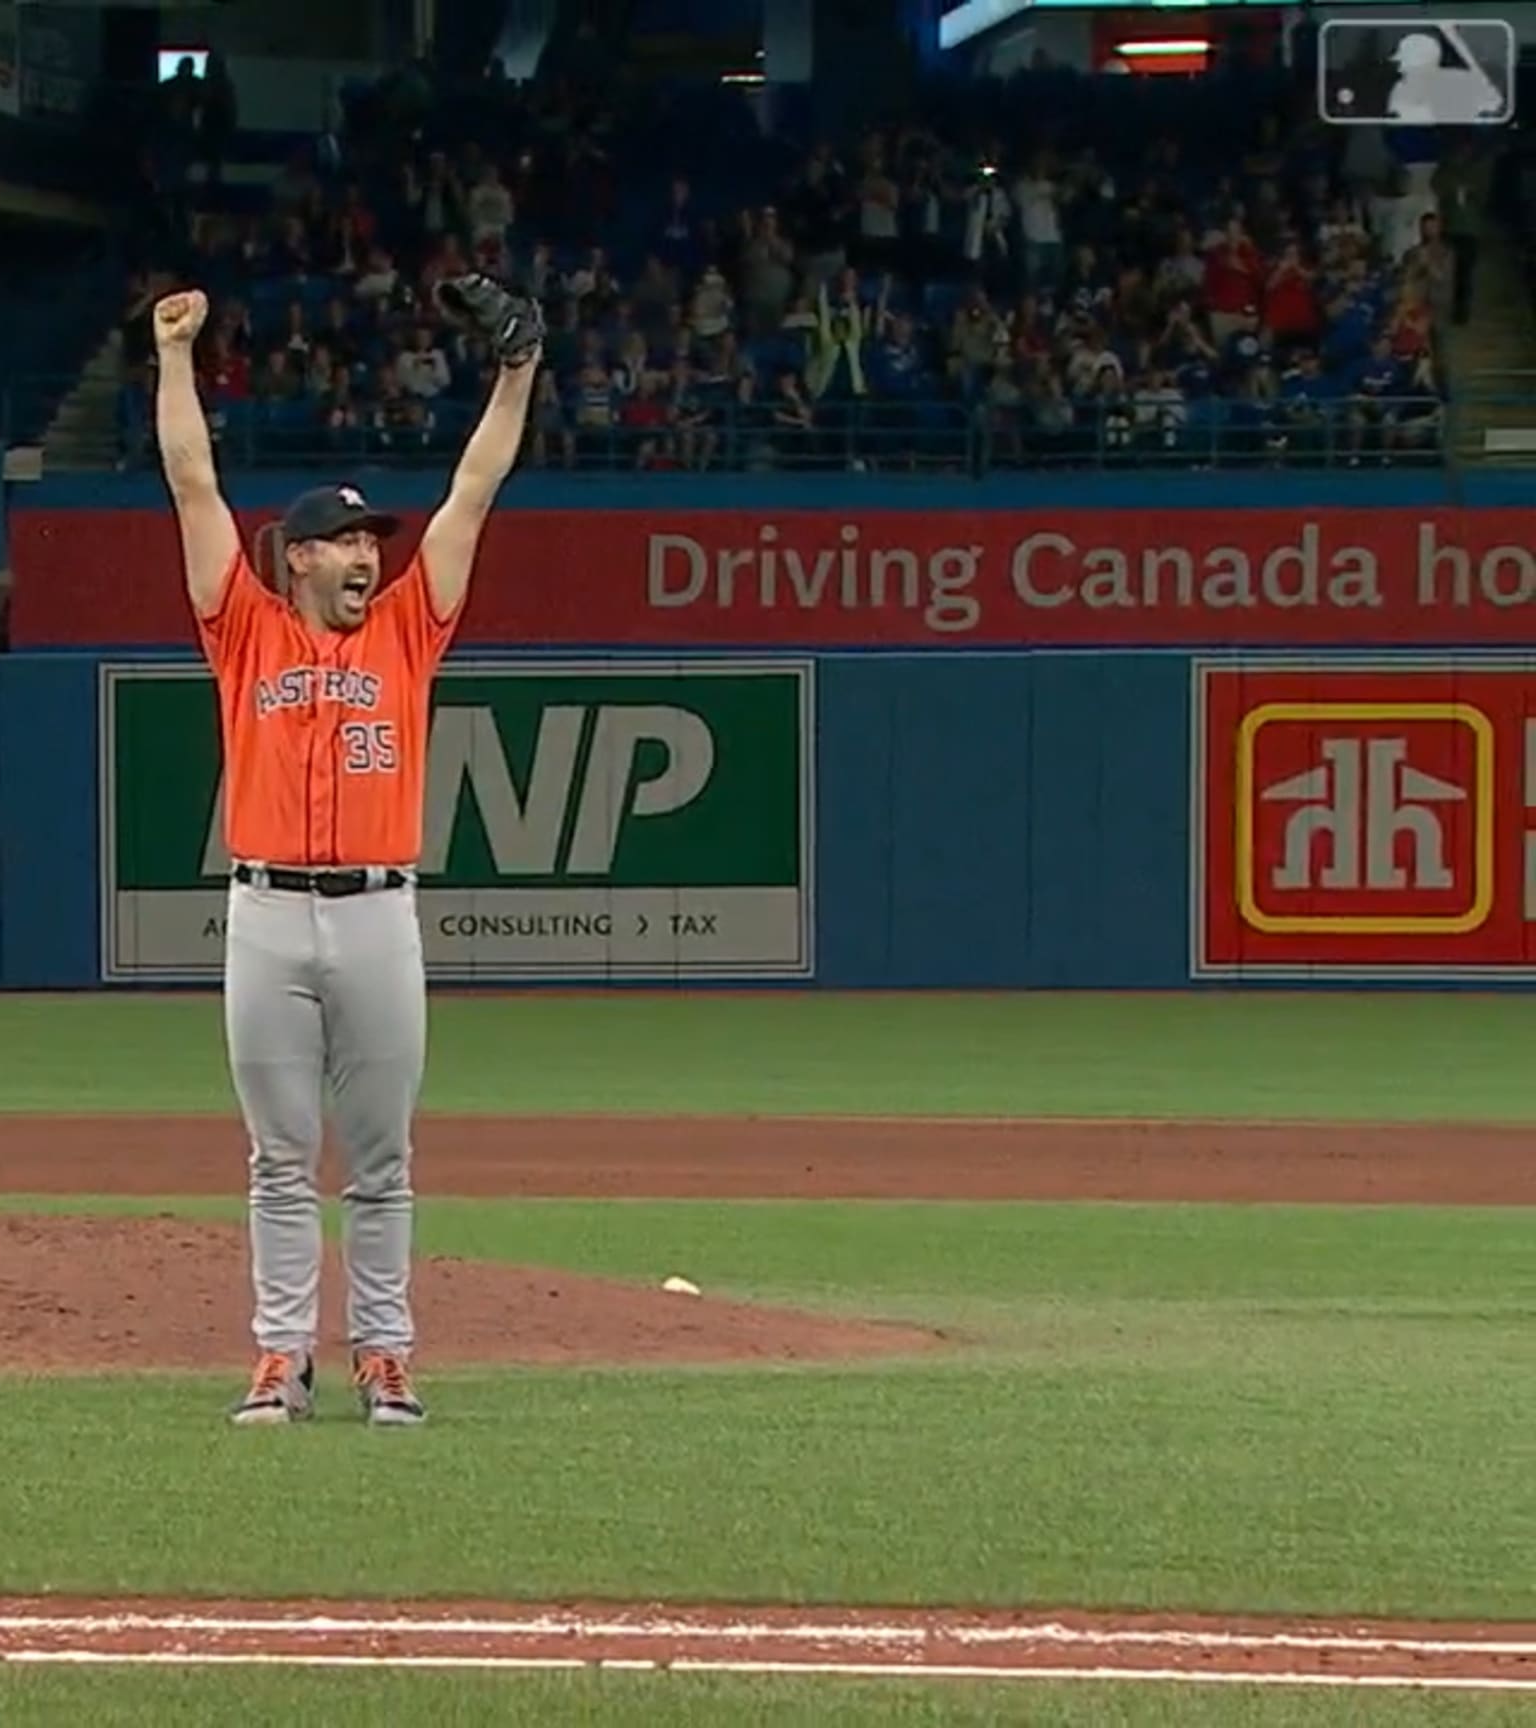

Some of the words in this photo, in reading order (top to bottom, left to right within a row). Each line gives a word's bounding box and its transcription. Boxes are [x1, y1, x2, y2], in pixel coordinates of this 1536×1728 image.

[647, 525, 983, 632] Driving
[1011, 522, 1382, 609] Canada
[255, 666, 382, 719] ASTROS
[341, 721, 397, 774] 35
[199, 704, 715, 876] NP
[439, 913, 612, 937] CONSULTING
[669, 914, 718, 936] TAX
